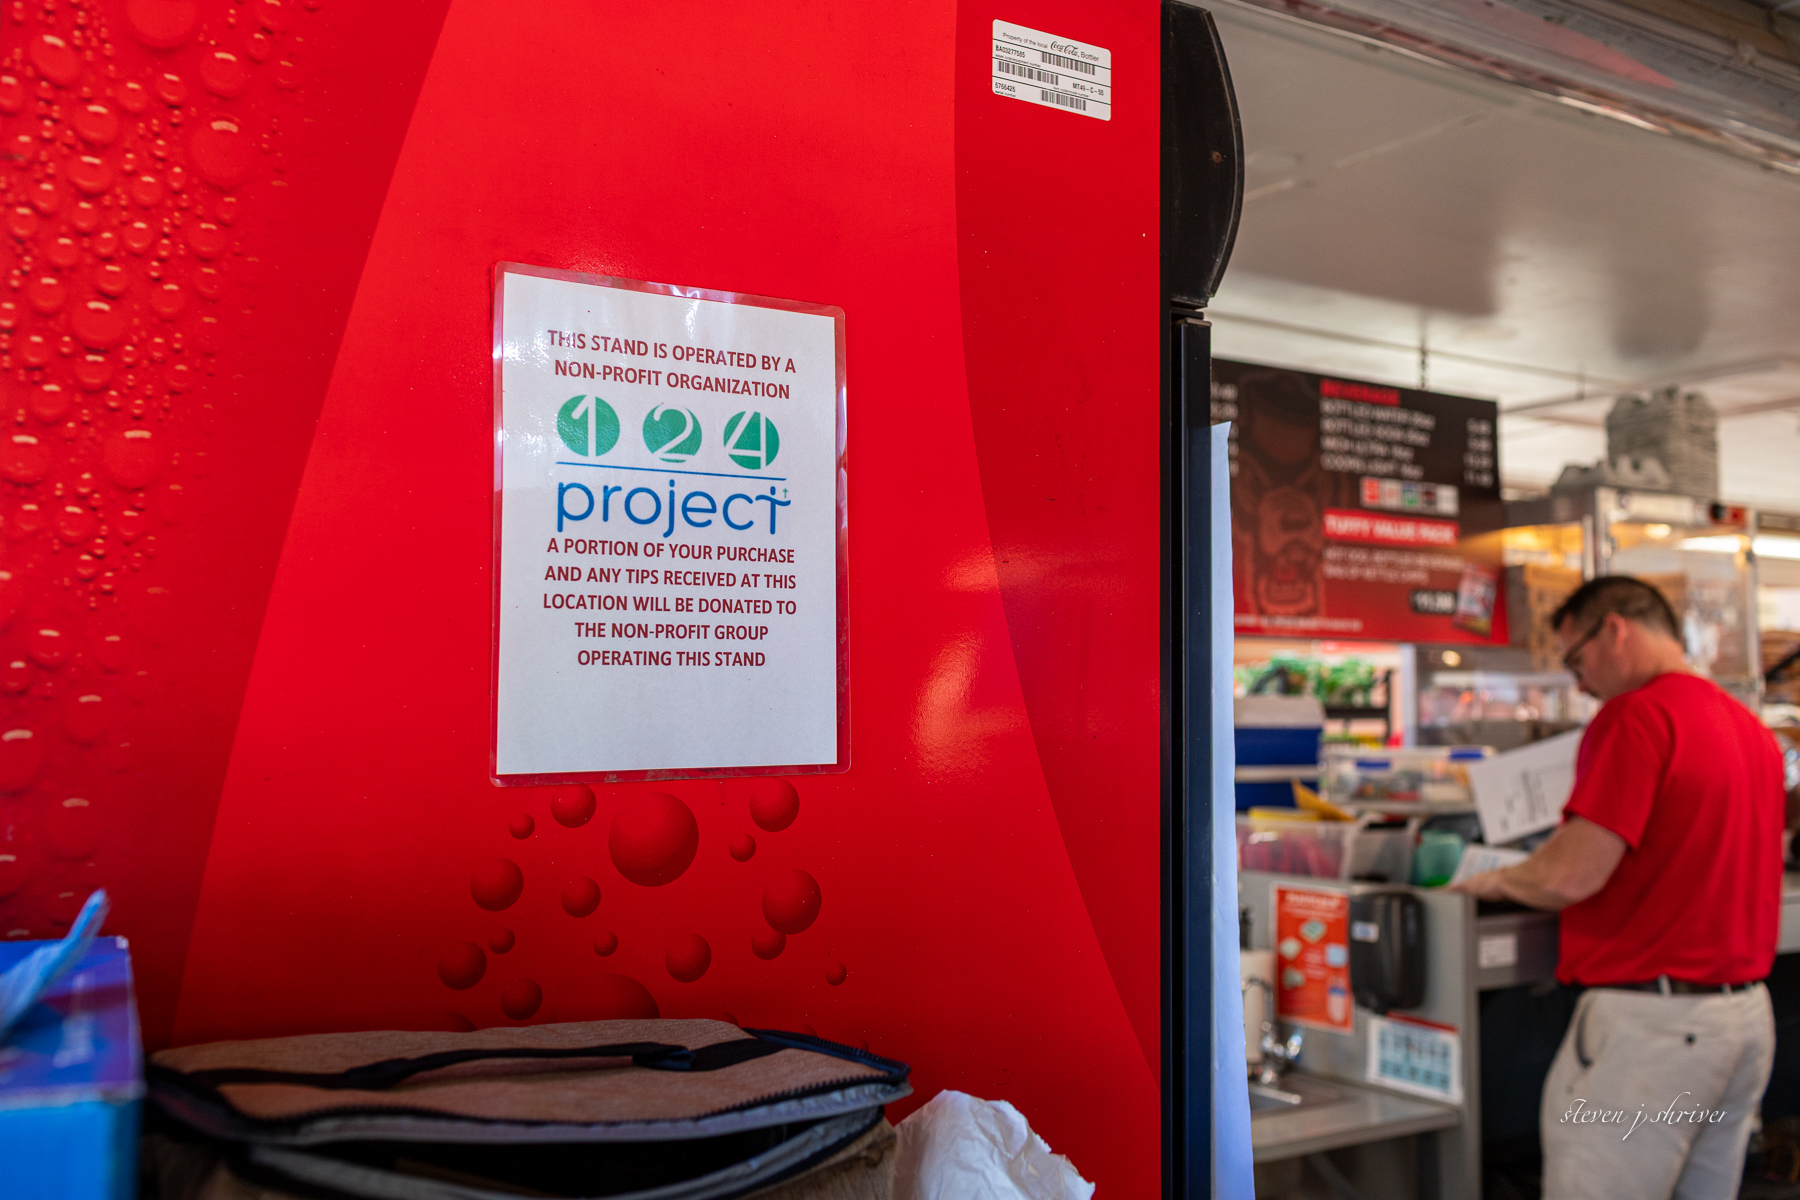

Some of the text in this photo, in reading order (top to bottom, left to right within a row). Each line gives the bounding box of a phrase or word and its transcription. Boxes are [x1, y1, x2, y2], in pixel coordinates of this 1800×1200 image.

[1003, 32, 1022, 43] Property
[1037, 41, 1048, 49] local
[1080, 51, 1099, 62] Bottler
[548, 330, 796, 373] THIS STAND IS OPERATED BY A
[556, 360, 789, 399] NON-PROFIT ORGANIZATION
[556, 478, 792, 539] project
[547, 538, 794, 563] A PORTION OF YOUR PURCHASE
[545, 566, 796, 589] AND ANY TIPS RECEIVED AT THIS
[544, 594, 796, 614] LOCATION WILL BE DONATED TO
[575, 622, 768, 640] THE NON-PROFIT GROUP
[578, 650, 765, 666] OPERATING THIS STAND
